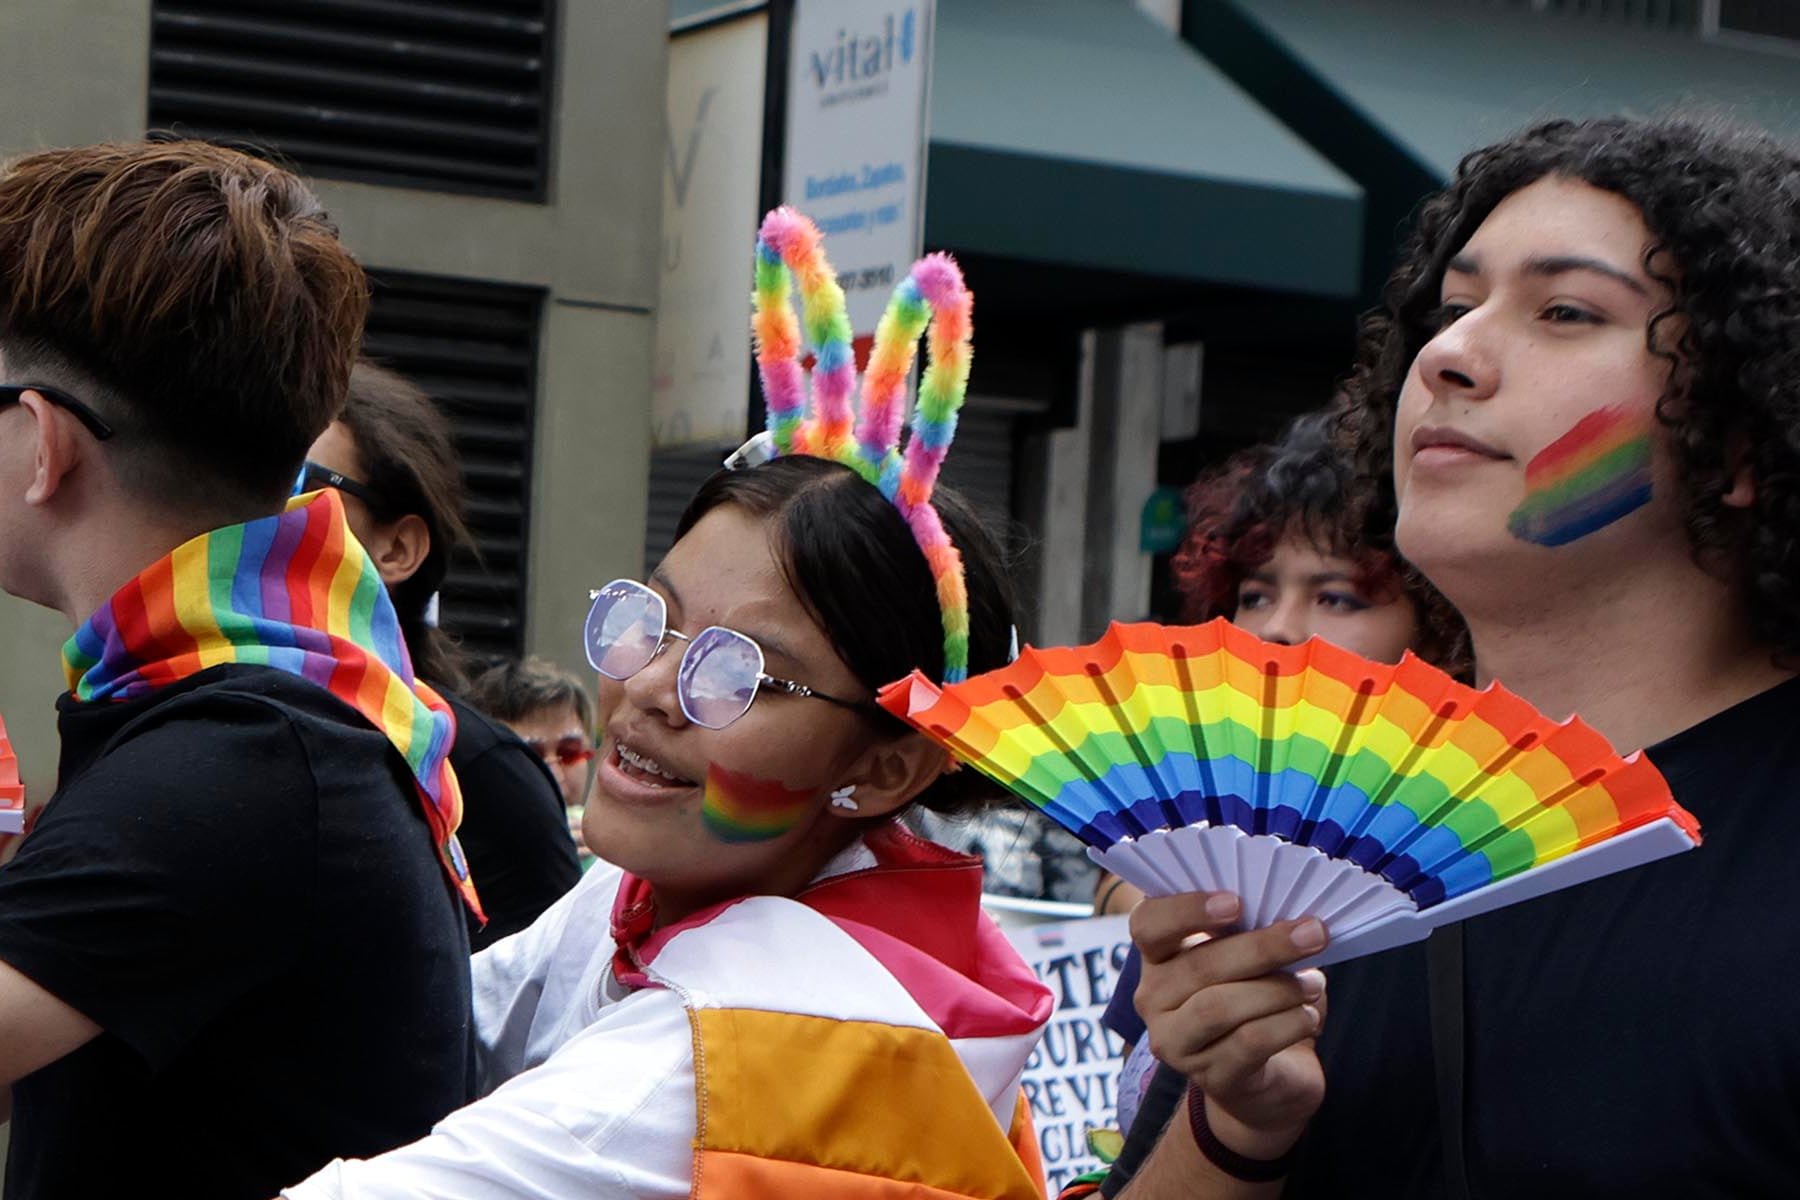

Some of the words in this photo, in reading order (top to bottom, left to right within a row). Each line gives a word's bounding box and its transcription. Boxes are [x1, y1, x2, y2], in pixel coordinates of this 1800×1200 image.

[810, 14, 894, 87] vital
[1031, 943, 1131, 1010] TES
[1020, 1072, 1121, 1117] REVI
